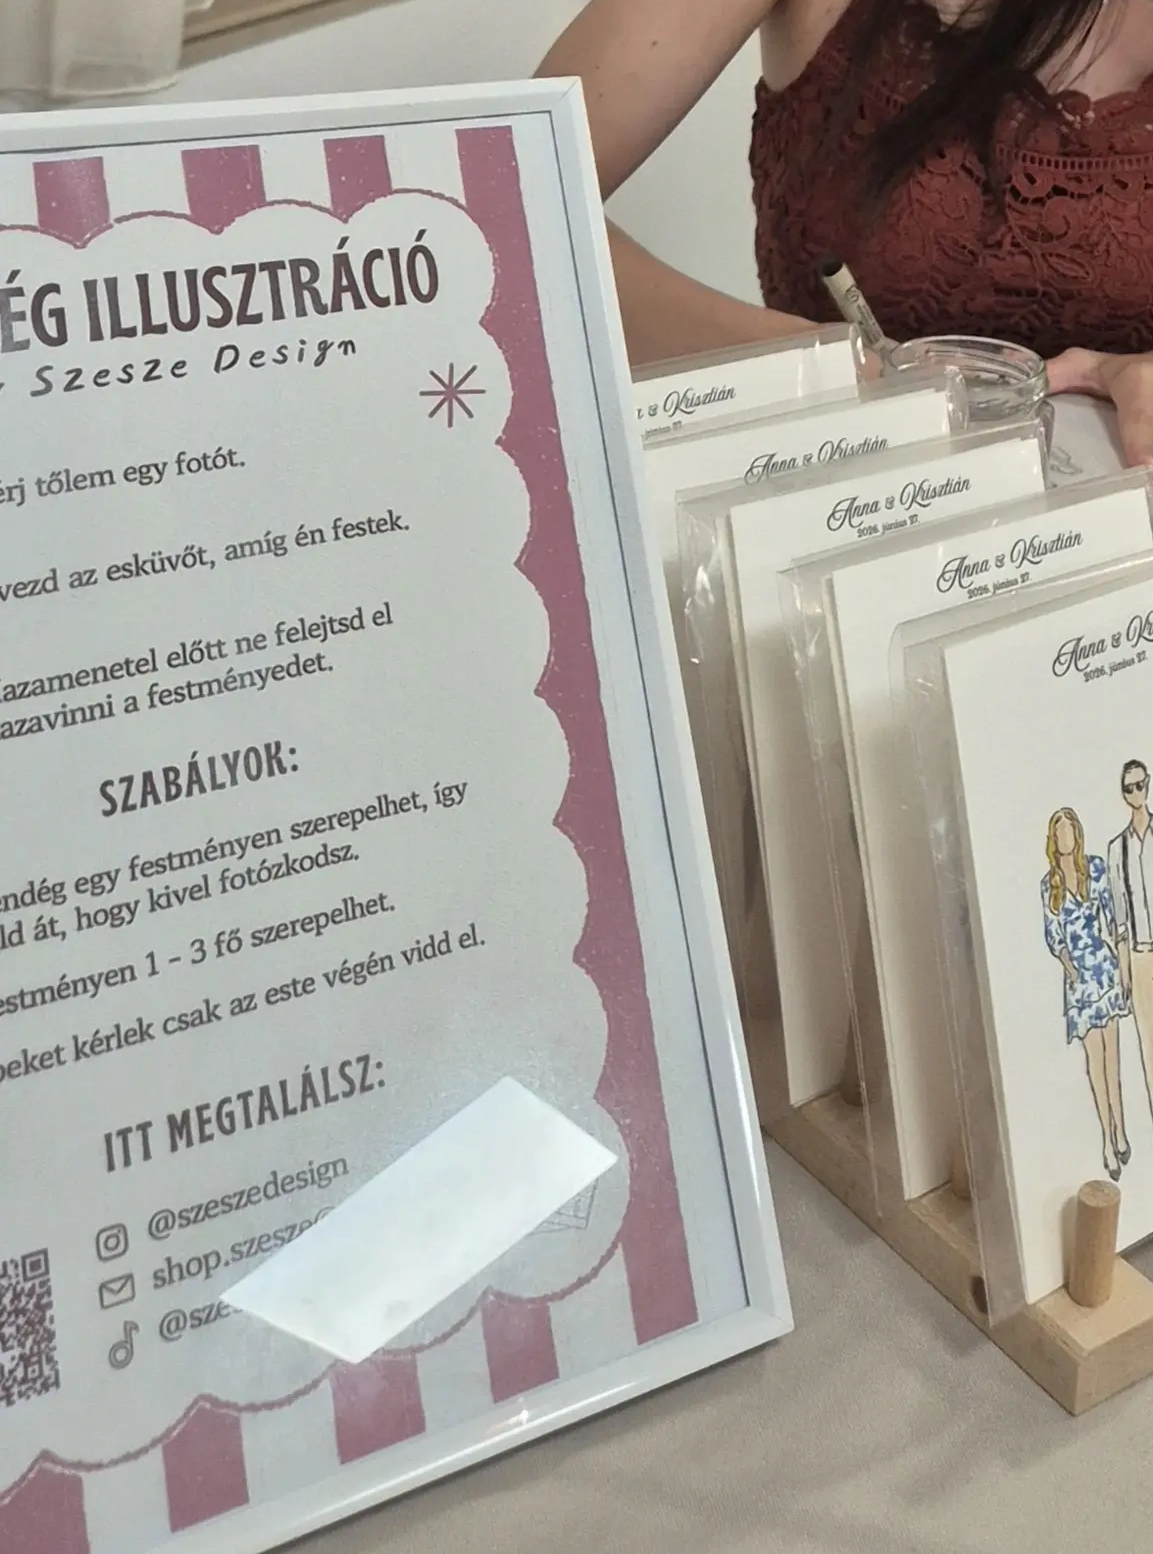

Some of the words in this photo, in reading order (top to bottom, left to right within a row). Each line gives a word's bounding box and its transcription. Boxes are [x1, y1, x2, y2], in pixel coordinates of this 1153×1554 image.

[0, 268, 68, 353] ÉG
[82, 229, 440, 342] ILLUSZTRÁCIÓ
[30, 357, 189, 397] Szesze
[213, 337, 357, 374] Design
[663, 384, 737, 418] Krisztián
[35, 468, 117, 497] tőlem
[123, 461, 169, 486] egy
[175, 447, 246, 477] fotót.
[744, 452, 799, 486] Anna
[817, 434, 888, 463] Krisztián
[826, 495, 881, 532] Anna
[900, 476, 972, 511] Krisztián
[68, 567, 98, 590] az
[106, 544, 216, 582] esküvőt,
[224, 531, 288, 557] amíg
[295, 524, 326, 548] én
[332, 509, 410, 542] festek.
[936, 554, 991, 594] Anna
[1010, 530, 1084, 569] Krisztián
[0, 648, 159, 703] azamenetel
[166, 639, 228, 669] előtt
[235, 633, 268, 655] ne
[275, 606, 366, 647] felejtsd
[372, 601, 394, 627] el
[1052, 635, 1108, 678] Anna
[0, 694, 116, 740] azavinni
[123, 695, 141, 714] a
[147, 652, 334, 709] festményedet.
[99, 740, 299, 817] SZABÁLYOK:
[74, 868, 121, 897] egy
[129, 826, 283, 882] festményen
[290, 791, 428, 840] szerepelhet,
[434, 781, 468, 808] így
[33, 914, 67, 941] át,
[74, 899, 141, 932] hogy
[147, 874, 212, 914] kivel
[219, 842, 360, 895] fotózkodsz.
[145, 950, 160, 978] 1
[190, 938, 207, 965] 3
[214, 927, 242, 958] fő
[251, 892, 396, 948] szerepelhet.
[72, 1017, 156, 1062] kérlek
[162, 997, 223, 1036] csak
[230, 993, 257, 1017] az
[265, 976, 316, 1006] este
[322, 951, 396, 986] végén
[400, 930, 453, 966] vidd
[458, 922, 486, 950] el.
[103, 1120, 154, 1174] ITT
[166, 1052, 386, 1153] MEGTALÁLSZ:
[147, 1156, 349, 1241] @szeszedesign
